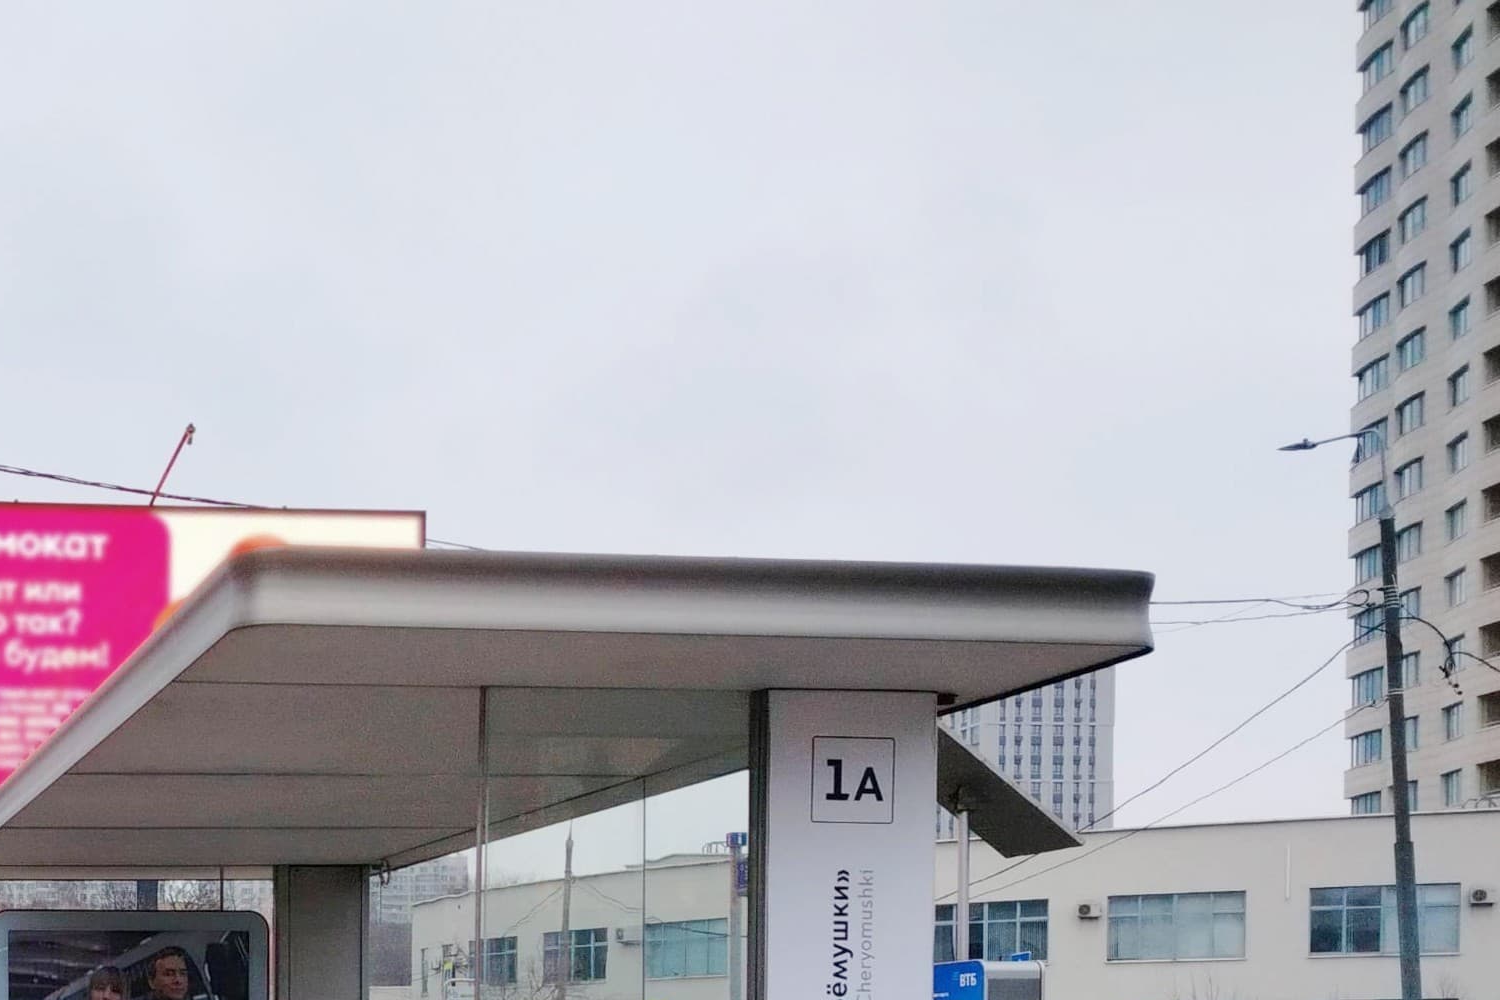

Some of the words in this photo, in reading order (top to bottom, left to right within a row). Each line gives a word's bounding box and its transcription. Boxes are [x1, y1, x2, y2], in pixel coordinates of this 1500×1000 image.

[24, 580, 82, 602] или
[15, 607, 82, 636] так?
[4, 637, 110, 674] будем!
[959, 973, 977, 987] ВТБ
